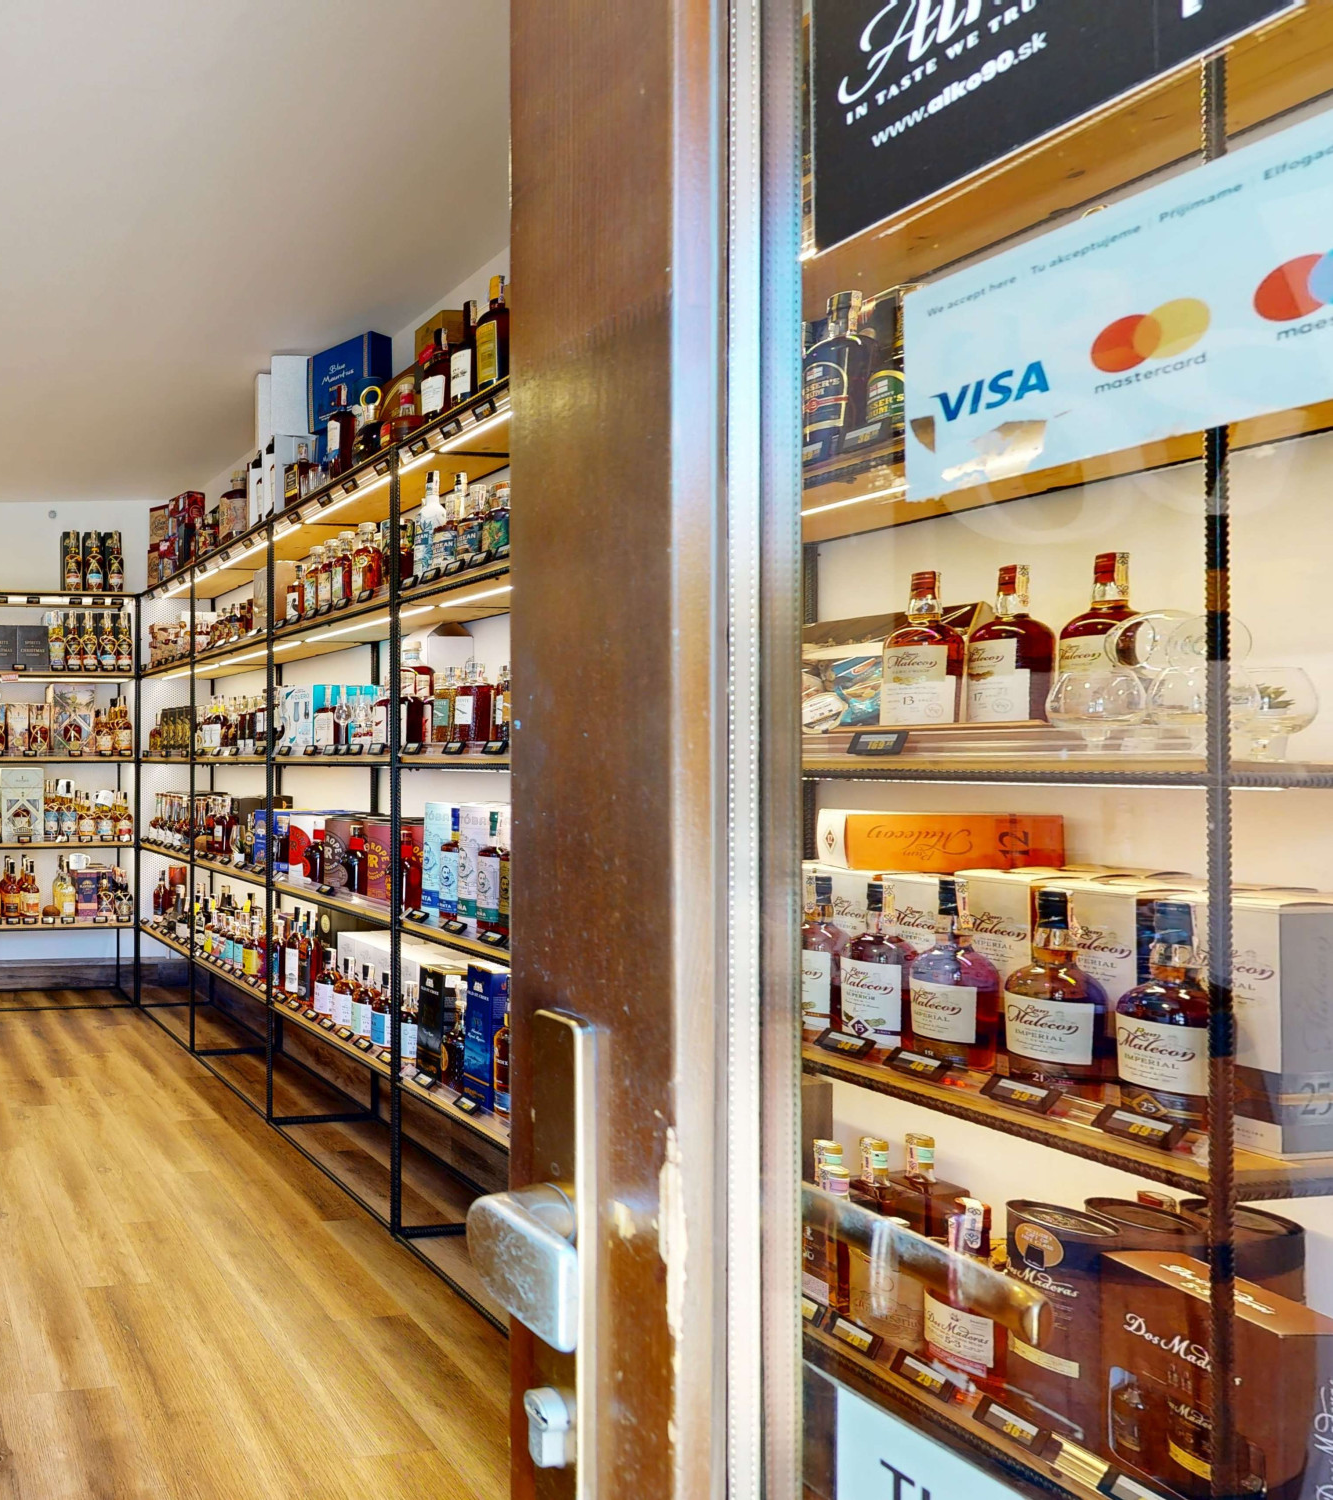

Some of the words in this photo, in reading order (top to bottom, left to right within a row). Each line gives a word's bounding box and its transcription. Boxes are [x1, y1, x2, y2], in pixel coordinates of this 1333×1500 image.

[845, 102, 869, 126] IN
[874, 57, 938, 106] TASTE
[945, 30, 981, 60] WE
[870, 31, 1049, 148] www.alko90.sk
[925, 306, 945, 318] We
[946, 286, 987, 311] accept
[988, 274, 1017, 294] here
[1029, 263, 1046, 277] Tu
[1048, 223, 1143, 269] akceptujeme
[328, 363, 346, 374] Blue
[1093, 350, 1208, 395] mastercard
[929, 360, 1051, 423] VISA
[887, 655, 939, 670] Malecon
[902, 695, 914, 706] 13
[973, 692, 983, 702] 17
[866, 824, 973, 856] Malecon
[997, 829, 1030, 860] 12
[894, 908, 935, 932] Maleco
[970, 914, 1028, 942] Malecon
[1077, 936, 1132, 960] alecon
[1078, 957, 1117, 969] PERIAL
[841, 968, 894, 995] Malecon
[911, 989, 962, 1016] Malecon
[1024, 1004, 1050, 1015] Rum
[1007, 1004, 1080, 1036] Malecon
[1134, 1027, 1161, 1039] Rum
[1015, 1028, 1066, 1043] IMPERIAL
[1117, 1026, 1197, 1063] Malecon
[1124, 1053, 1180, 1070] IMPERIAL
[1032, 1072, 1044, 1083] 21
[1140, 1101, 1156, 1114] 25
[1300, 1081, 1333, 1117] 25
[1018, 1267, 1079, 1298] Maderas
[942, 1321, 990, 1346] Maderas
[1123, 1312, 1160, 1344] Dos
